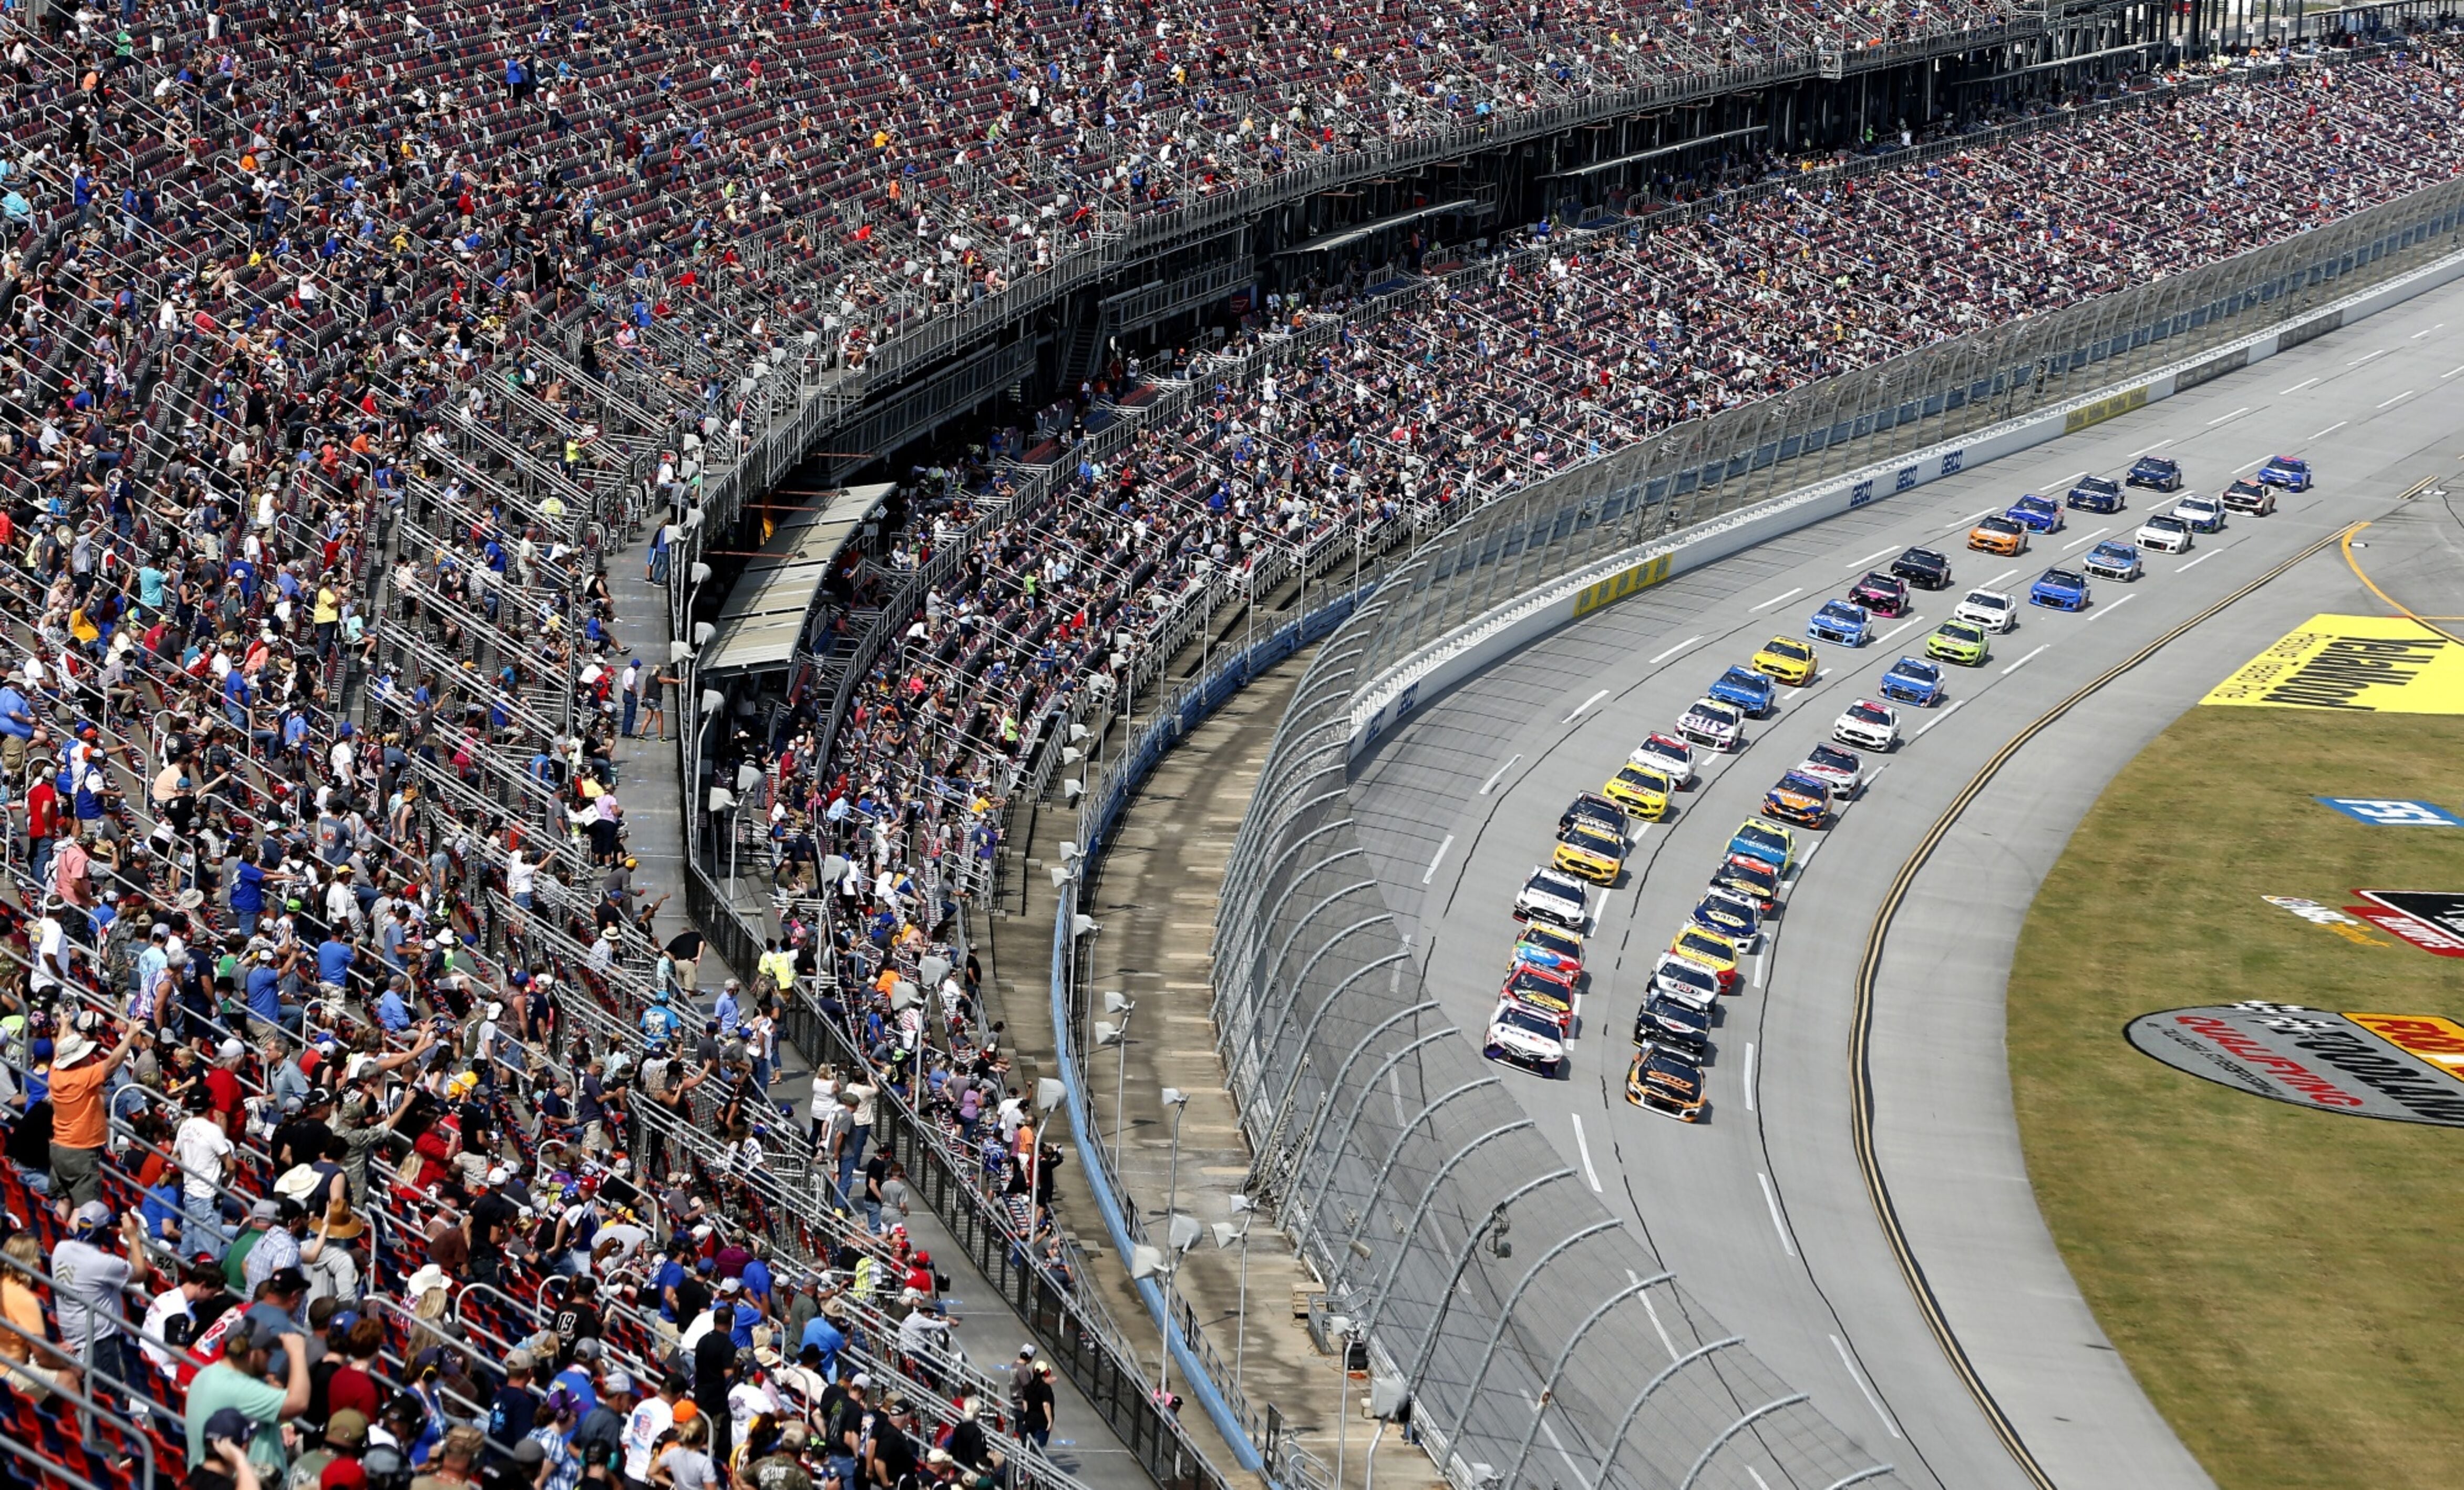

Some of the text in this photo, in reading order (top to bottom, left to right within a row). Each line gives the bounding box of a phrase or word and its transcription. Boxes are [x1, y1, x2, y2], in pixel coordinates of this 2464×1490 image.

[1941, 450, 1963, 475] GEICO
[1895, 466, 1918, 491] GEICO
[1850, 479, 1873, 507] GEICO
[2260, 636, 2449, 712] YellaWood
[2333, 799, 2457, 825] FS1
[1712, 912, 1740, 924] NAPA
[2174, 1015, 2364, 1106] QUALIFYING
[157, 1257, 172, 1270] 52
[559, 1313, 577, 1333] 19
